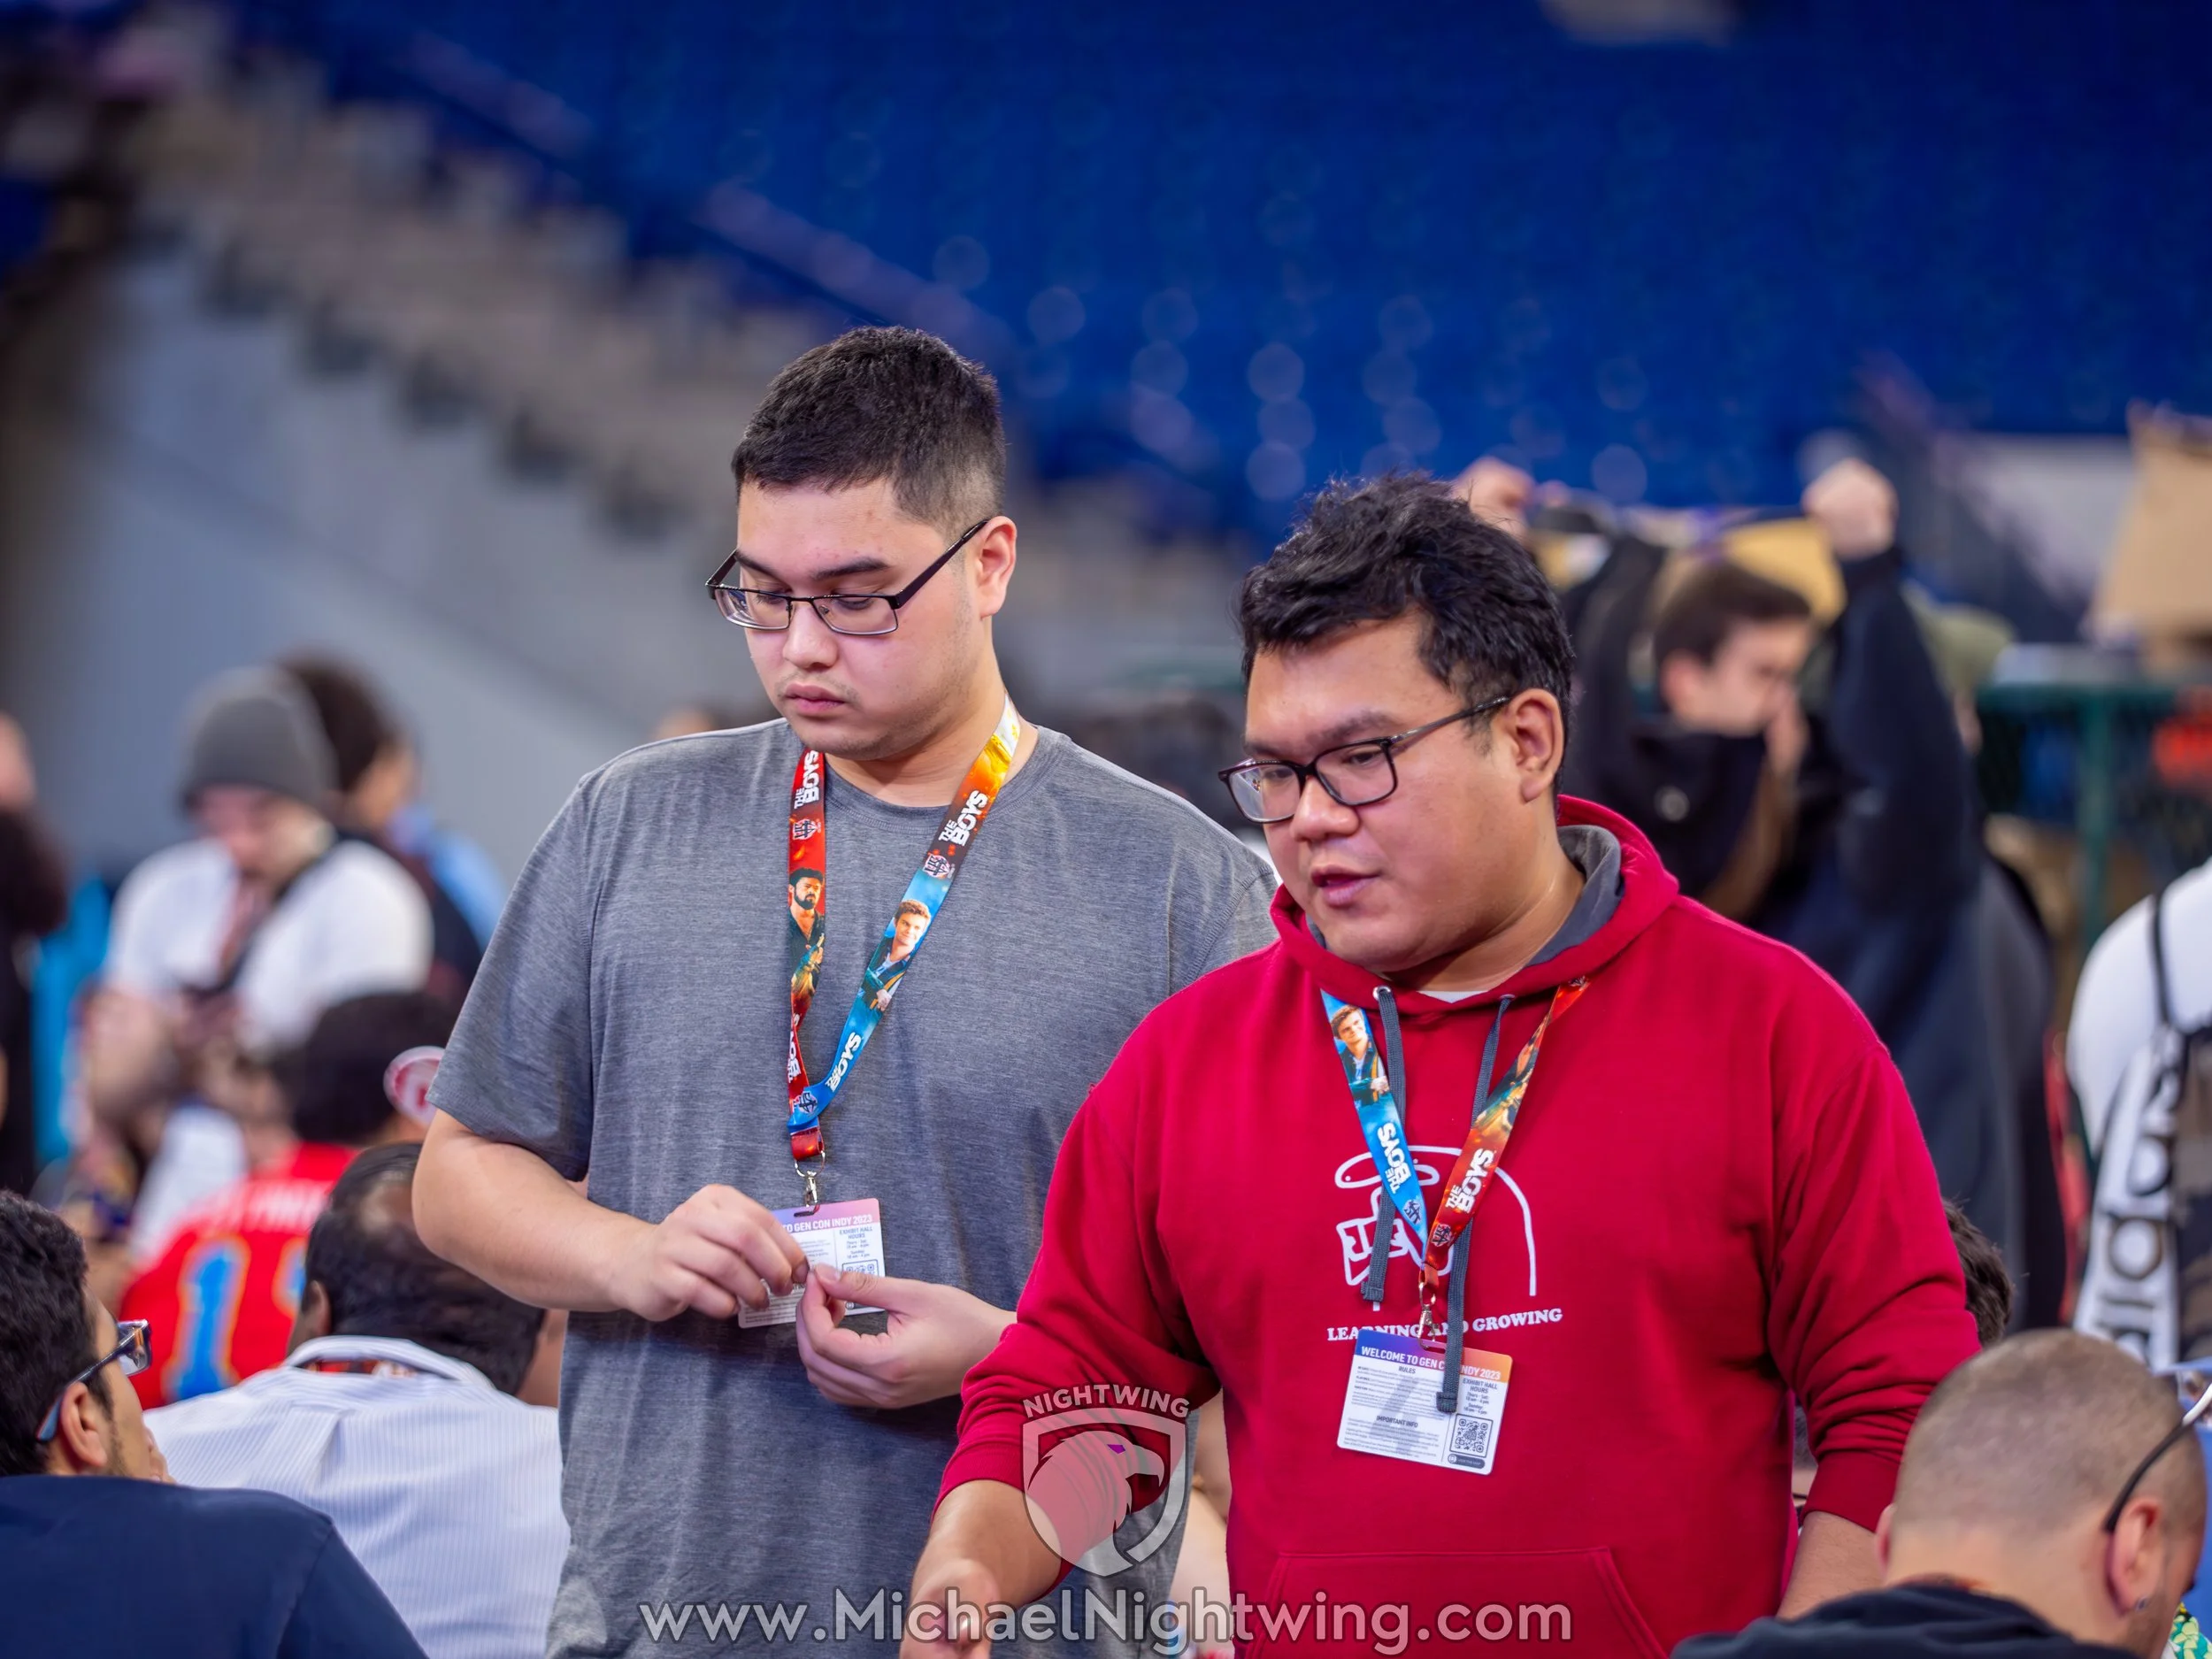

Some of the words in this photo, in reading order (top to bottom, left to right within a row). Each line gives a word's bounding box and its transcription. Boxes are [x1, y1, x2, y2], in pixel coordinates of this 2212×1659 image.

[803, 750, 819, 804] BOYS
[794, 787, 804, 809] THE
[939, 819, 958, 841] THE
[951, 790, 989, 846] BOYS
[830, 1032, 862, 1092] BOYS
[1377, 1122, 1411, 1184] BOYS
[1385, 1167, 1400, 1194] THE
[1456, 1148, 1494, 1213] BOYS
[1445, 1185, 1463, 1209] THE
[794, 1222, 811, 1232] GEN
[812, 1219, 830, 1230] CON
[832, 1217, 852, 1227] INDY
[852, 1215, 872, 1225] 2023
[1472, 1308, 1563, 1332] GROWING
[1361, 1346, 1406, 1364] WELCOME
[1407, 1355, 1417, 1365] TO
[1418, 1356, 1438, 1370] GEN
[1461, 1365, 1480, 1377] NDY
[1479, 1368, 1502, 1380] 2023
[1398, 1365, 1416, 1374] RULES
[1463, 1378, 1484, 1386] EXHIBIT
[1376, 1415, 1406, 1426] IMPORTANT
[1406, 1419, 1418, 1428] INFO
